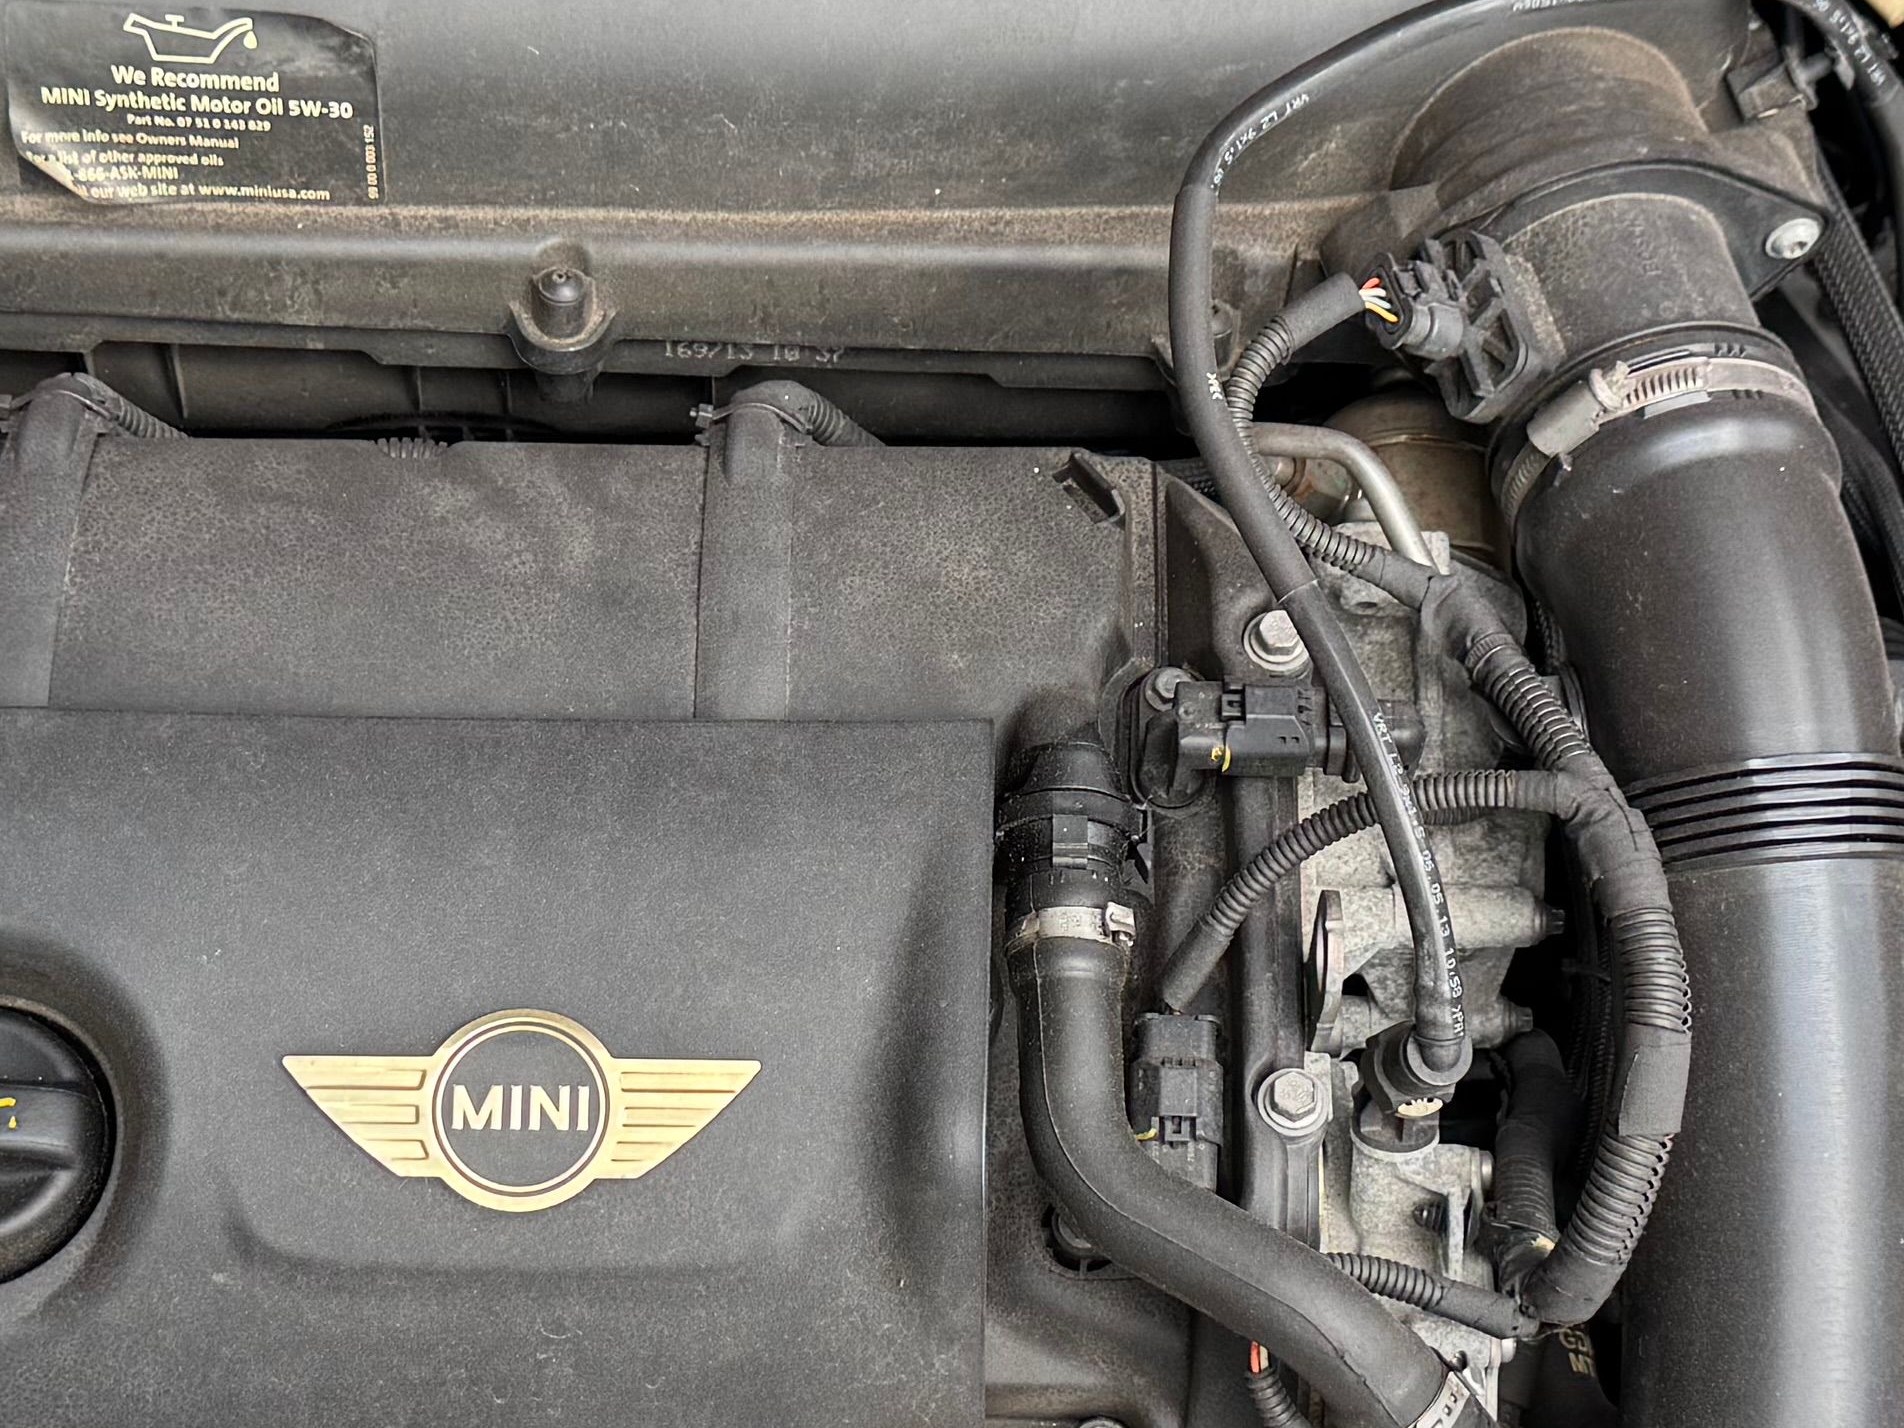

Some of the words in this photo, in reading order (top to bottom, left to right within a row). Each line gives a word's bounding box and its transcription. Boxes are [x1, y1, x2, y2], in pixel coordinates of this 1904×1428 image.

[111, 64, 146, 86] We
[151, 67, 279, 93] Recommend
[41, 87, 91, 106] MINI
[94, 89, 187, 112] Synthetic
[190, 94, 252, 114] Motor
[255, 97, 284, 116] Oil
[288, 99, 353, 119] 5W-30
[127, 113, 152, 126] Part
[154, 115, 176, 127] No.
[20, 130, 42, 144] For
[45, 131, 81, 144] more
[111, 132, 134, 144] see
[136, 132, 187, 146] Owners
[188, 134, 239, 149] Manual
[81, 150, 96, 164] of
[98, 150, 134, 164] other
[137, 153, 198, 166] approved
[201, 154, 224, 166] oils
[116, 183, 148, 198] web
[150, 183, 177, 196] site
[180, 184, 195, 195] at
[198, 184, 330, 201] www.miniusa.com
[449, 1084, 590, 1133] MINI
